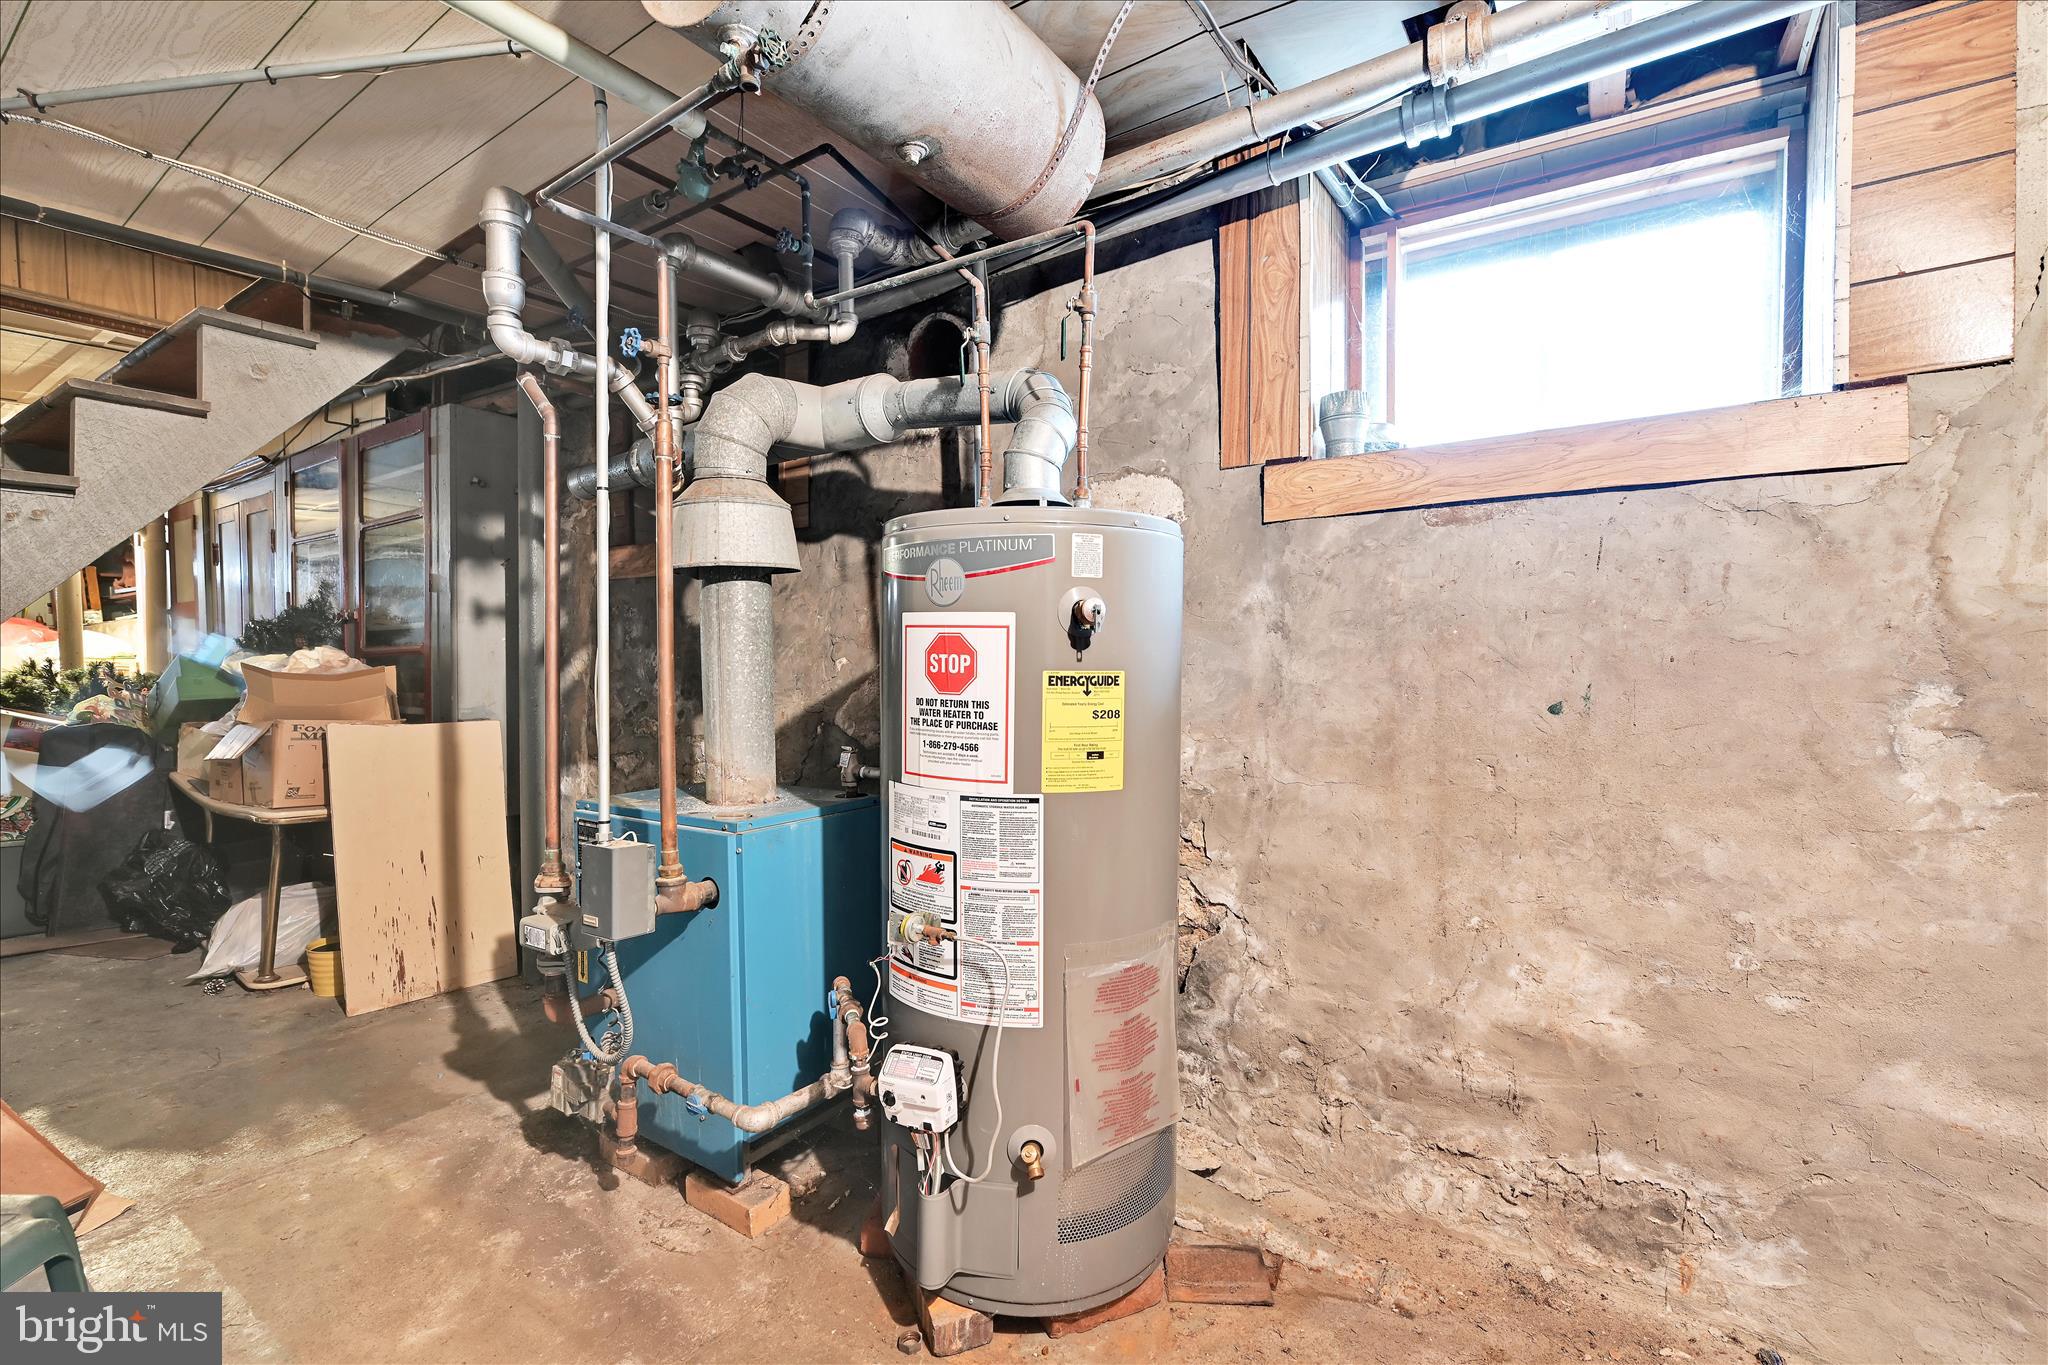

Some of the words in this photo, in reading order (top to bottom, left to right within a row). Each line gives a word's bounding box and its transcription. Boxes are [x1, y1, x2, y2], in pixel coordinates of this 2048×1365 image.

[930, 559, 962, 598] Rheem
[929, 652, 971, 675] STOP
[1048, 675, 1120, 687] ENERGYGUIDE
[915, 697, 924, 706] DO
[925, 698, 938, 707] NOT
[940, 699, 969, 709] RETURN
[971, 700, 990, 710] THIS
[919, 708, 941, 718] WATER
[943, 709, 972, 719] HEATER
[974, 710, 984, 720] TO
[1092, 709, 1120, 720] $208
[910, 717, 921, 726] THE
[922, 718, 943, 728] PLACE
[944, 719, 954, 729] OF
[955, 720, 999, 731] PURCHASE
[922, 740, 979, 752] 1-866-279-4566
